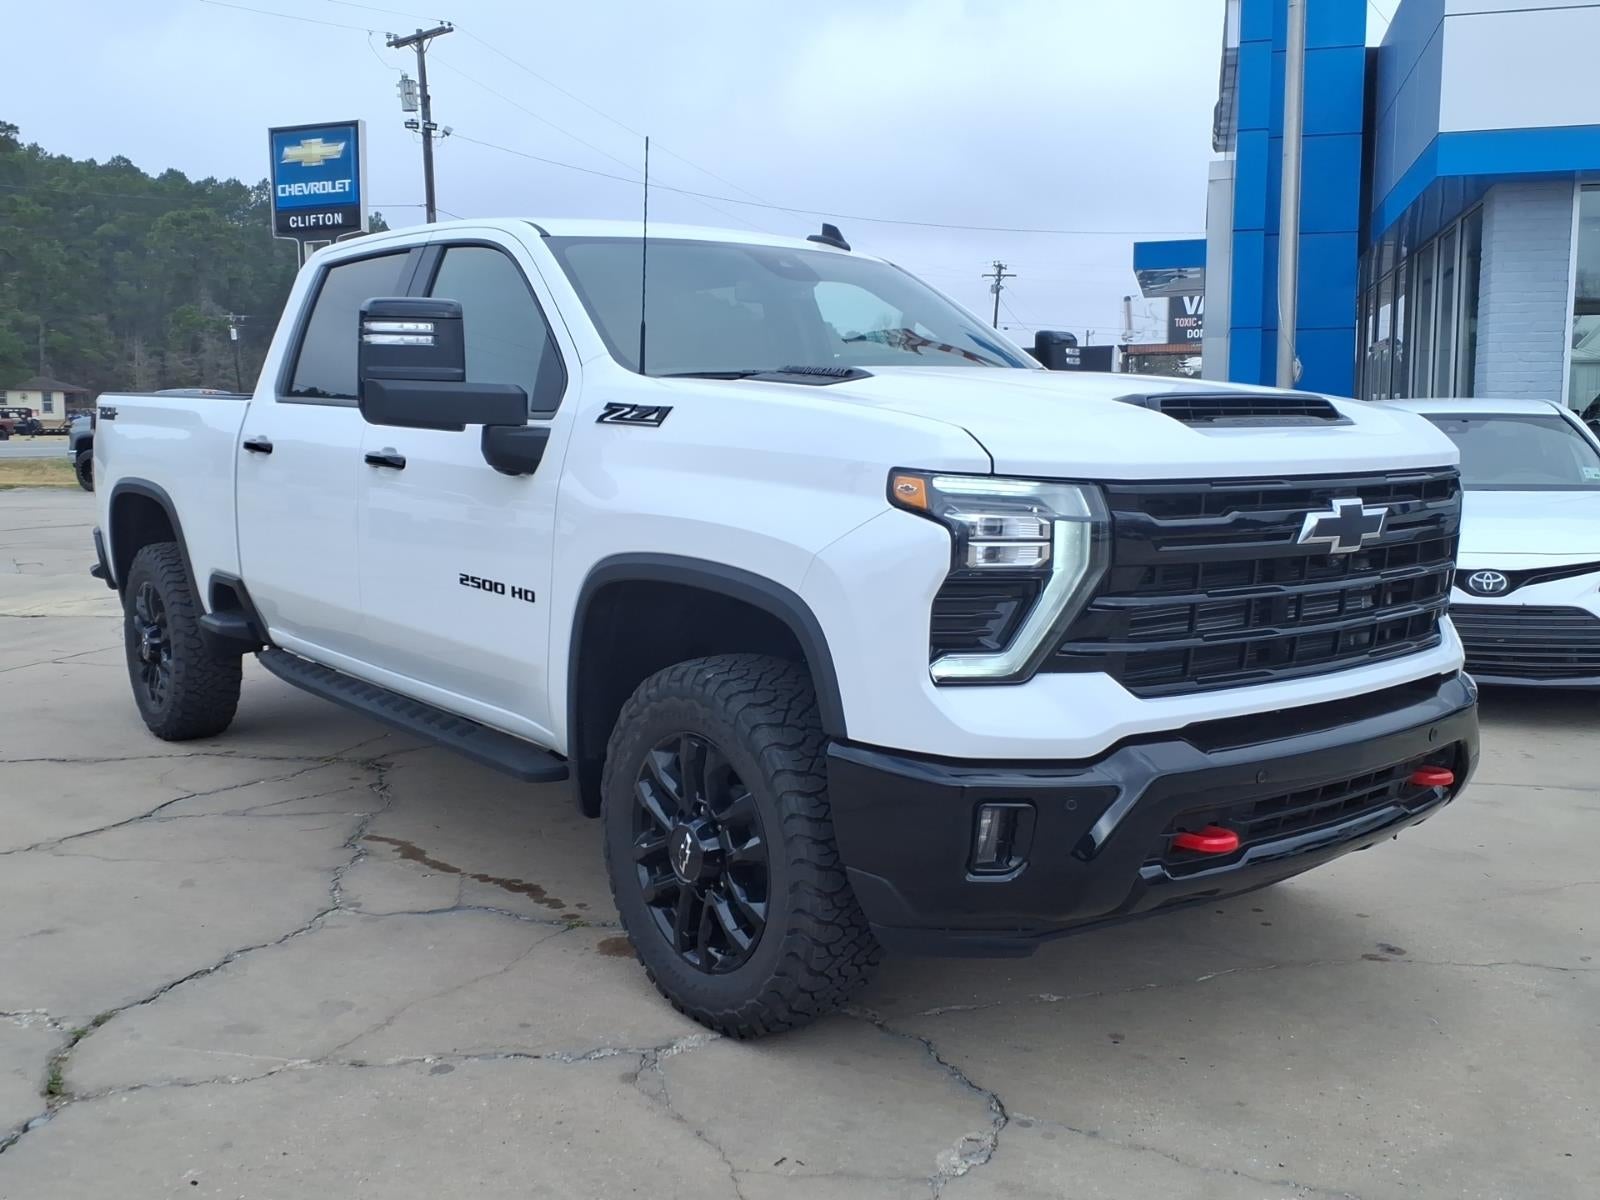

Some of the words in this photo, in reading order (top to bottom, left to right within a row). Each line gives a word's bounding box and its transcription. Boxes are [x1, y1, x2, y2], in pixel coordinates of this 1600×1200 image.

[277, 179, 352, 197] CHEVROLET
[289, 212, 343, 228] CLIFTON
[1174, 317, 1197, 327] TOXIC
[459, 573, 506, 596] 2500
[510, 585, 536, 604] HD
